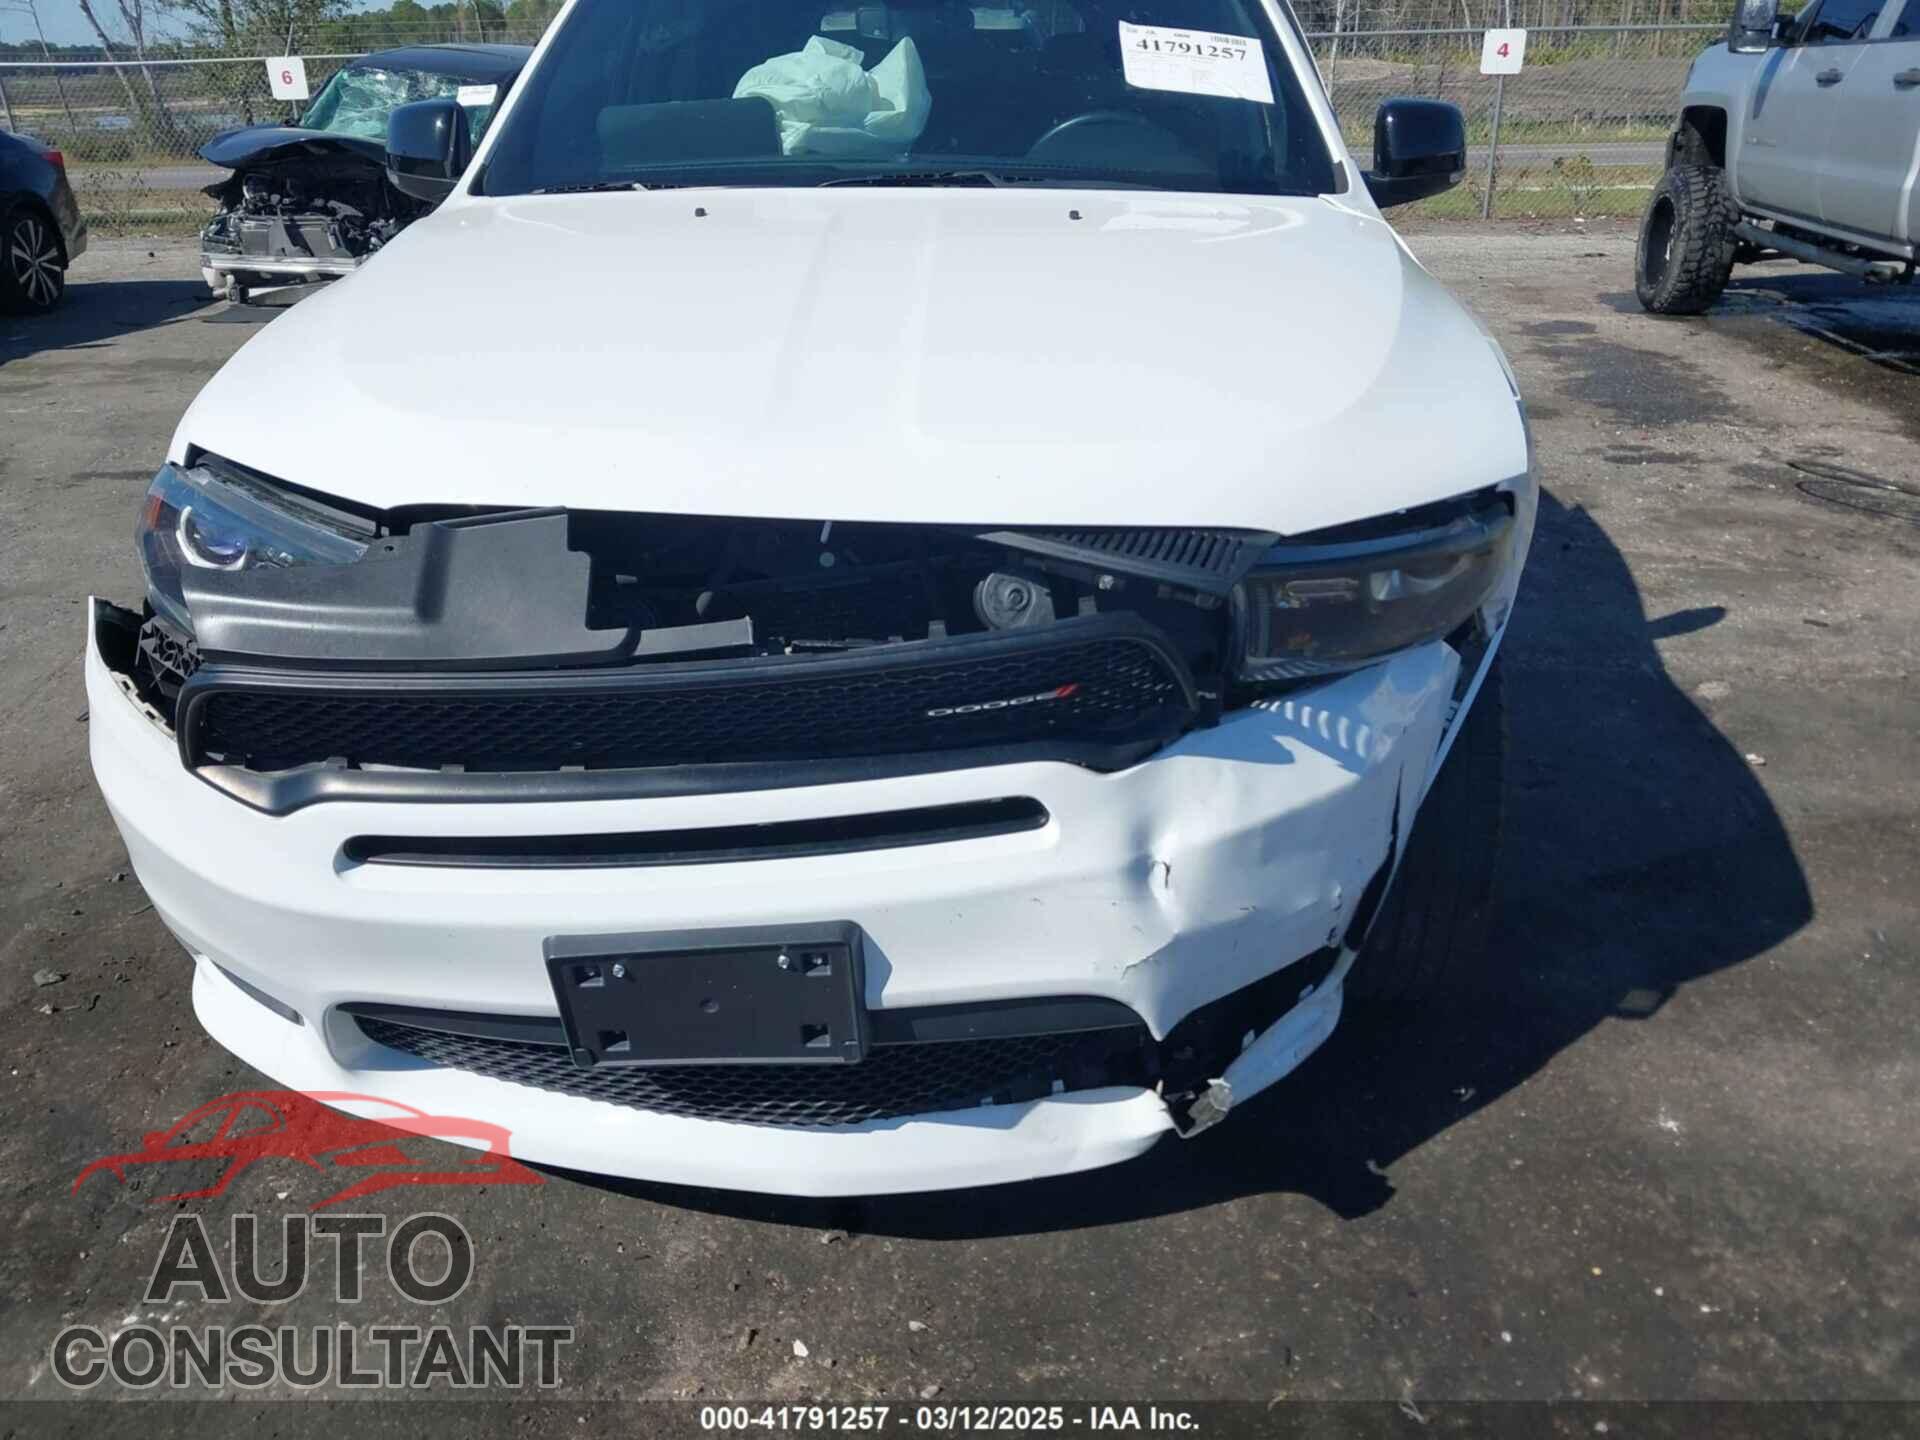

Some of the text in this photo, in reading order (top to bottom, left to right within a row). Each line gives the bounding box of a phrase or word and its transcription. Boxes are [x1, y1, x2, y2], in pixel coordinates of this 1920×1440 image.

[1136, 39, 1246, 61] 41791257
[1497, 43, 1509, 57] 4
[282, 70, 293, 85] 6
